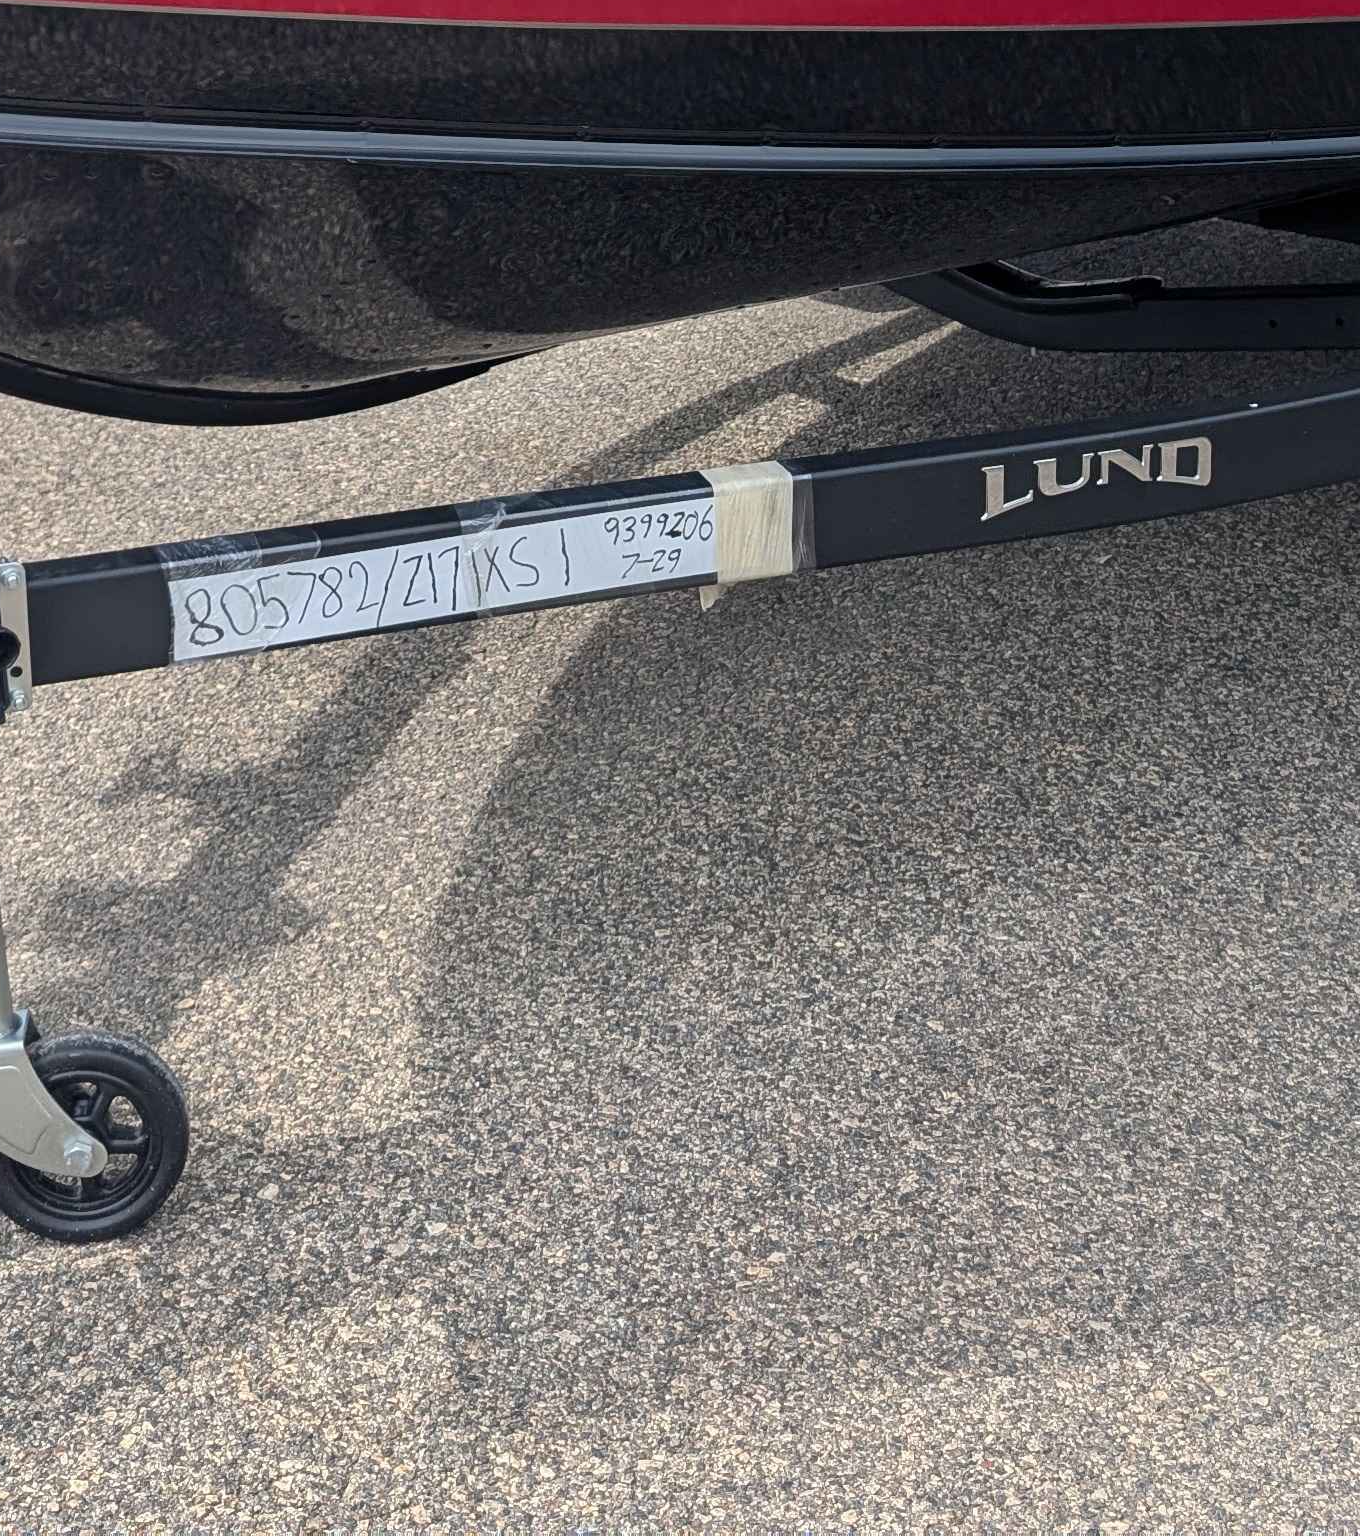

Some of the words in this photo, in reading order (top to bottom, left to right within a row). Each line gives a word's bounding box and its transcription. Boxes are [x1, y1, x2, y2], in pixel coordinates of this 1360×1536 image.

[980, 436, 1213, 522] LUND
[604, 504, 714, 545] 9399206
[622, 548, 682, 579] 7-29
